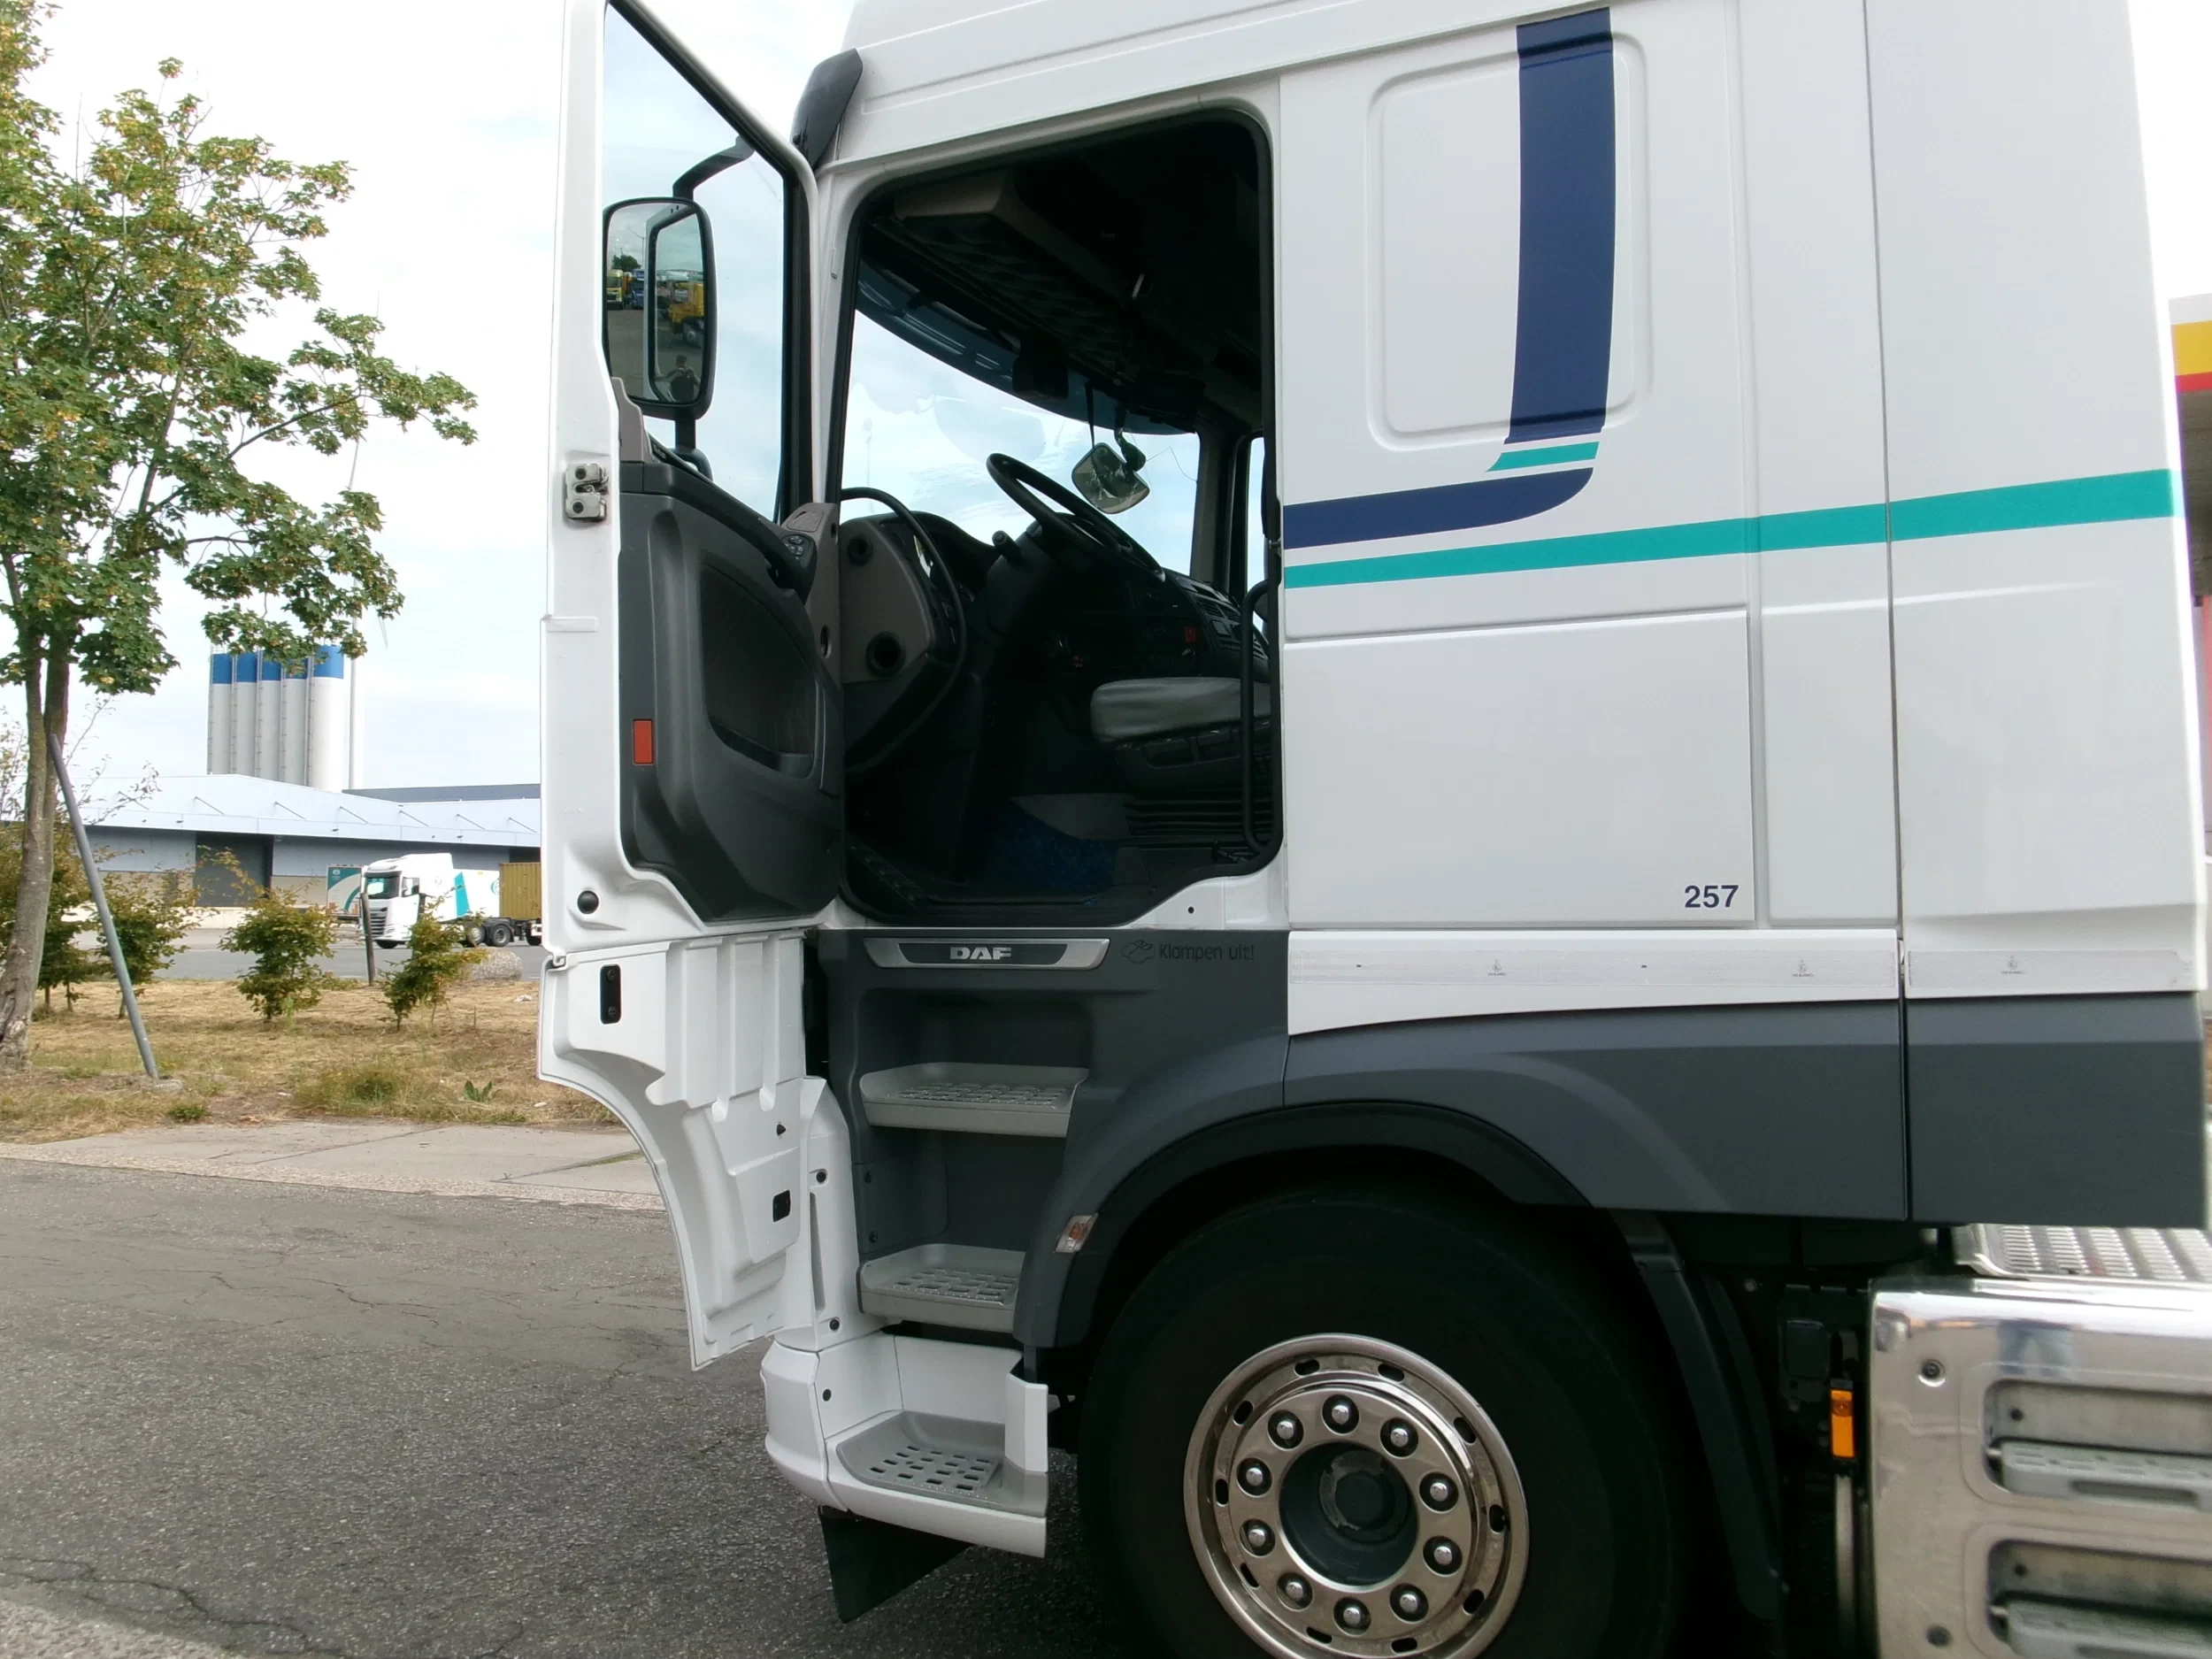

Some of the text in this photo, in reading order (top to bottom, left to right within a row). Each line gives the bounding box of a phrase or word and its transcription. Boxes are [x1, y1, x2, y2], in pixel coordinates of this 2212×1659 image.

[1685, 885, 1739, 908] 257
[950, 947, 1011, 960] DAF
[1160, 944, 1254, 961] Klompen uit!
